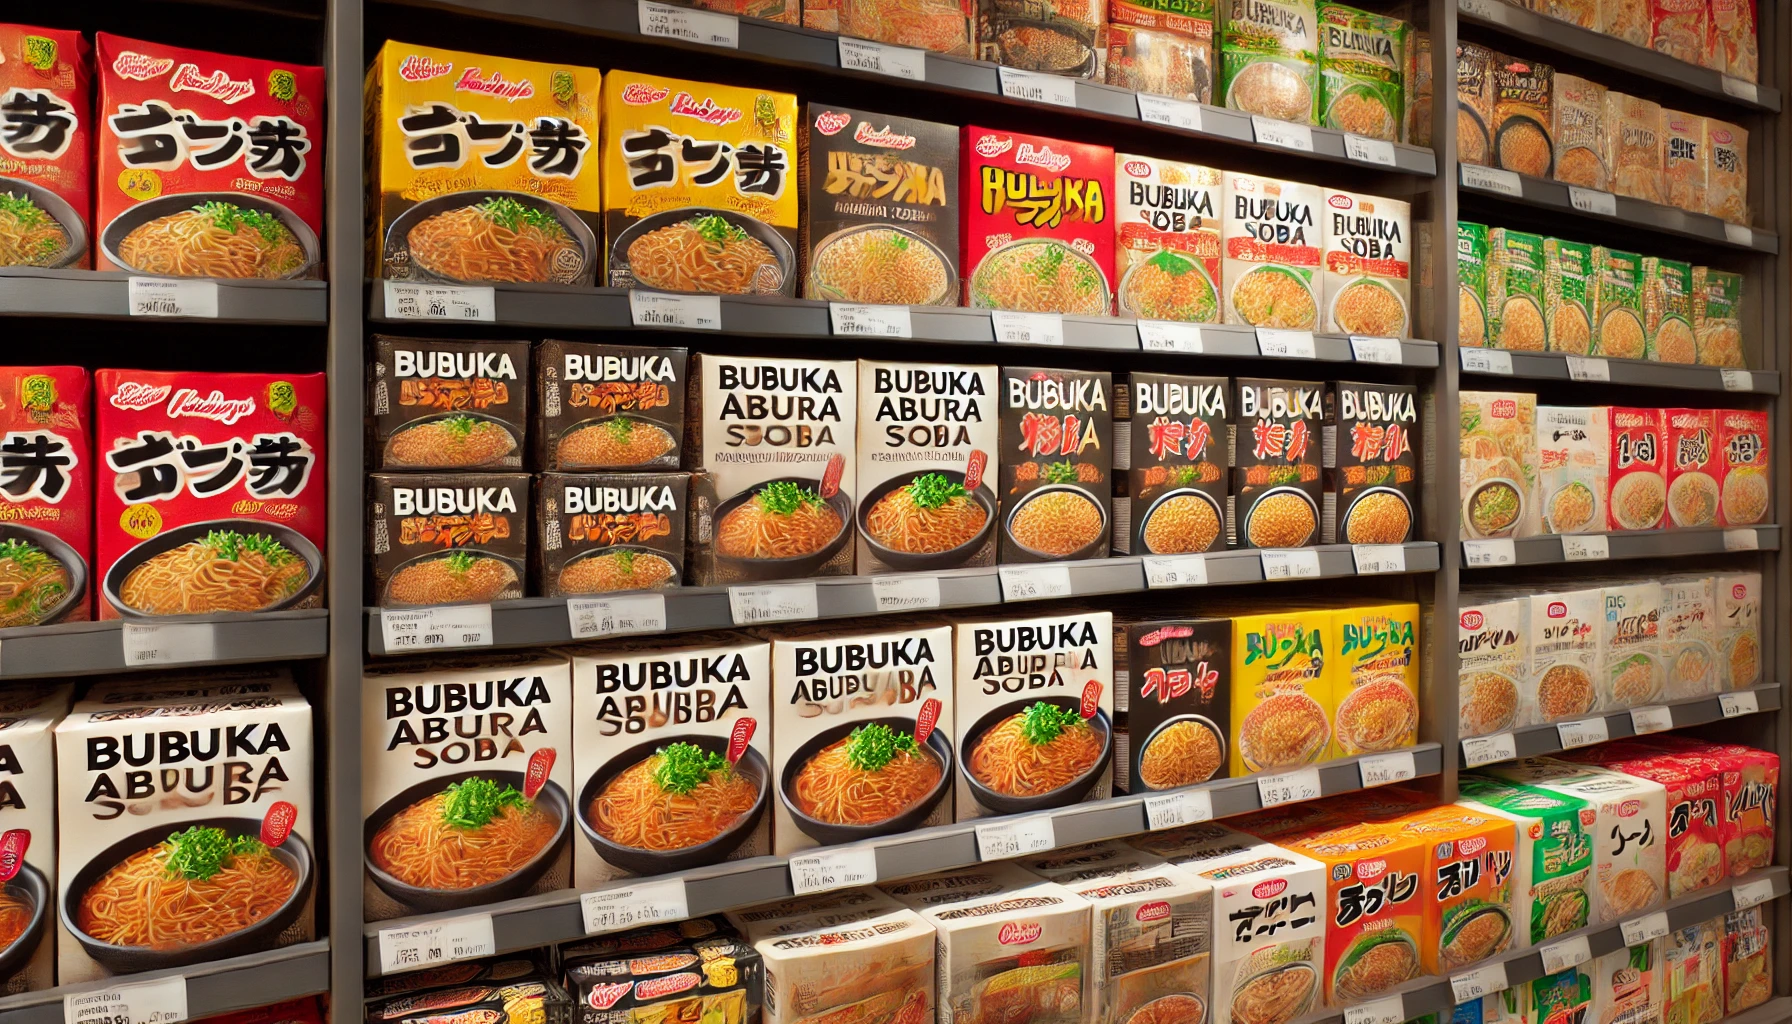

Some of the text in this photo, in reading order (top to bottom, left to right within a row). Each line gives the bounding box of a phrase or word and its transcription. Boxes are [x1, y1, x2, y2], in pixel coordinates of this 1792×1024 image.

[394, 350, 517, 380] BUBUKA
[564, 354, 676, 382] BUBUKA
[719, 364, 842, 394] BUBUKA
[874, 368, 985, 396] BUBUKA
[1008, 378, 1107, 412] BUBUKA
[719, 393, 841, 422] ABURA
[875, 396, 982, 422] ABURA
[1136, 382, 1226, 418] BUBUKA
[393, 486, 517, 516] BUBUKA
[564, 485, 676, 514] BUBUKA
[974, 621, 1098, 656] BUBUKA
[795, 637, 935, 677] BUBUKA
[595, 653, 751, 695] BUBUKA
[386, 676, 551, 720] BUBUKA
[386, 707, 548, 751] ABURA
[86, 722, 291, 771] BUBUKA
